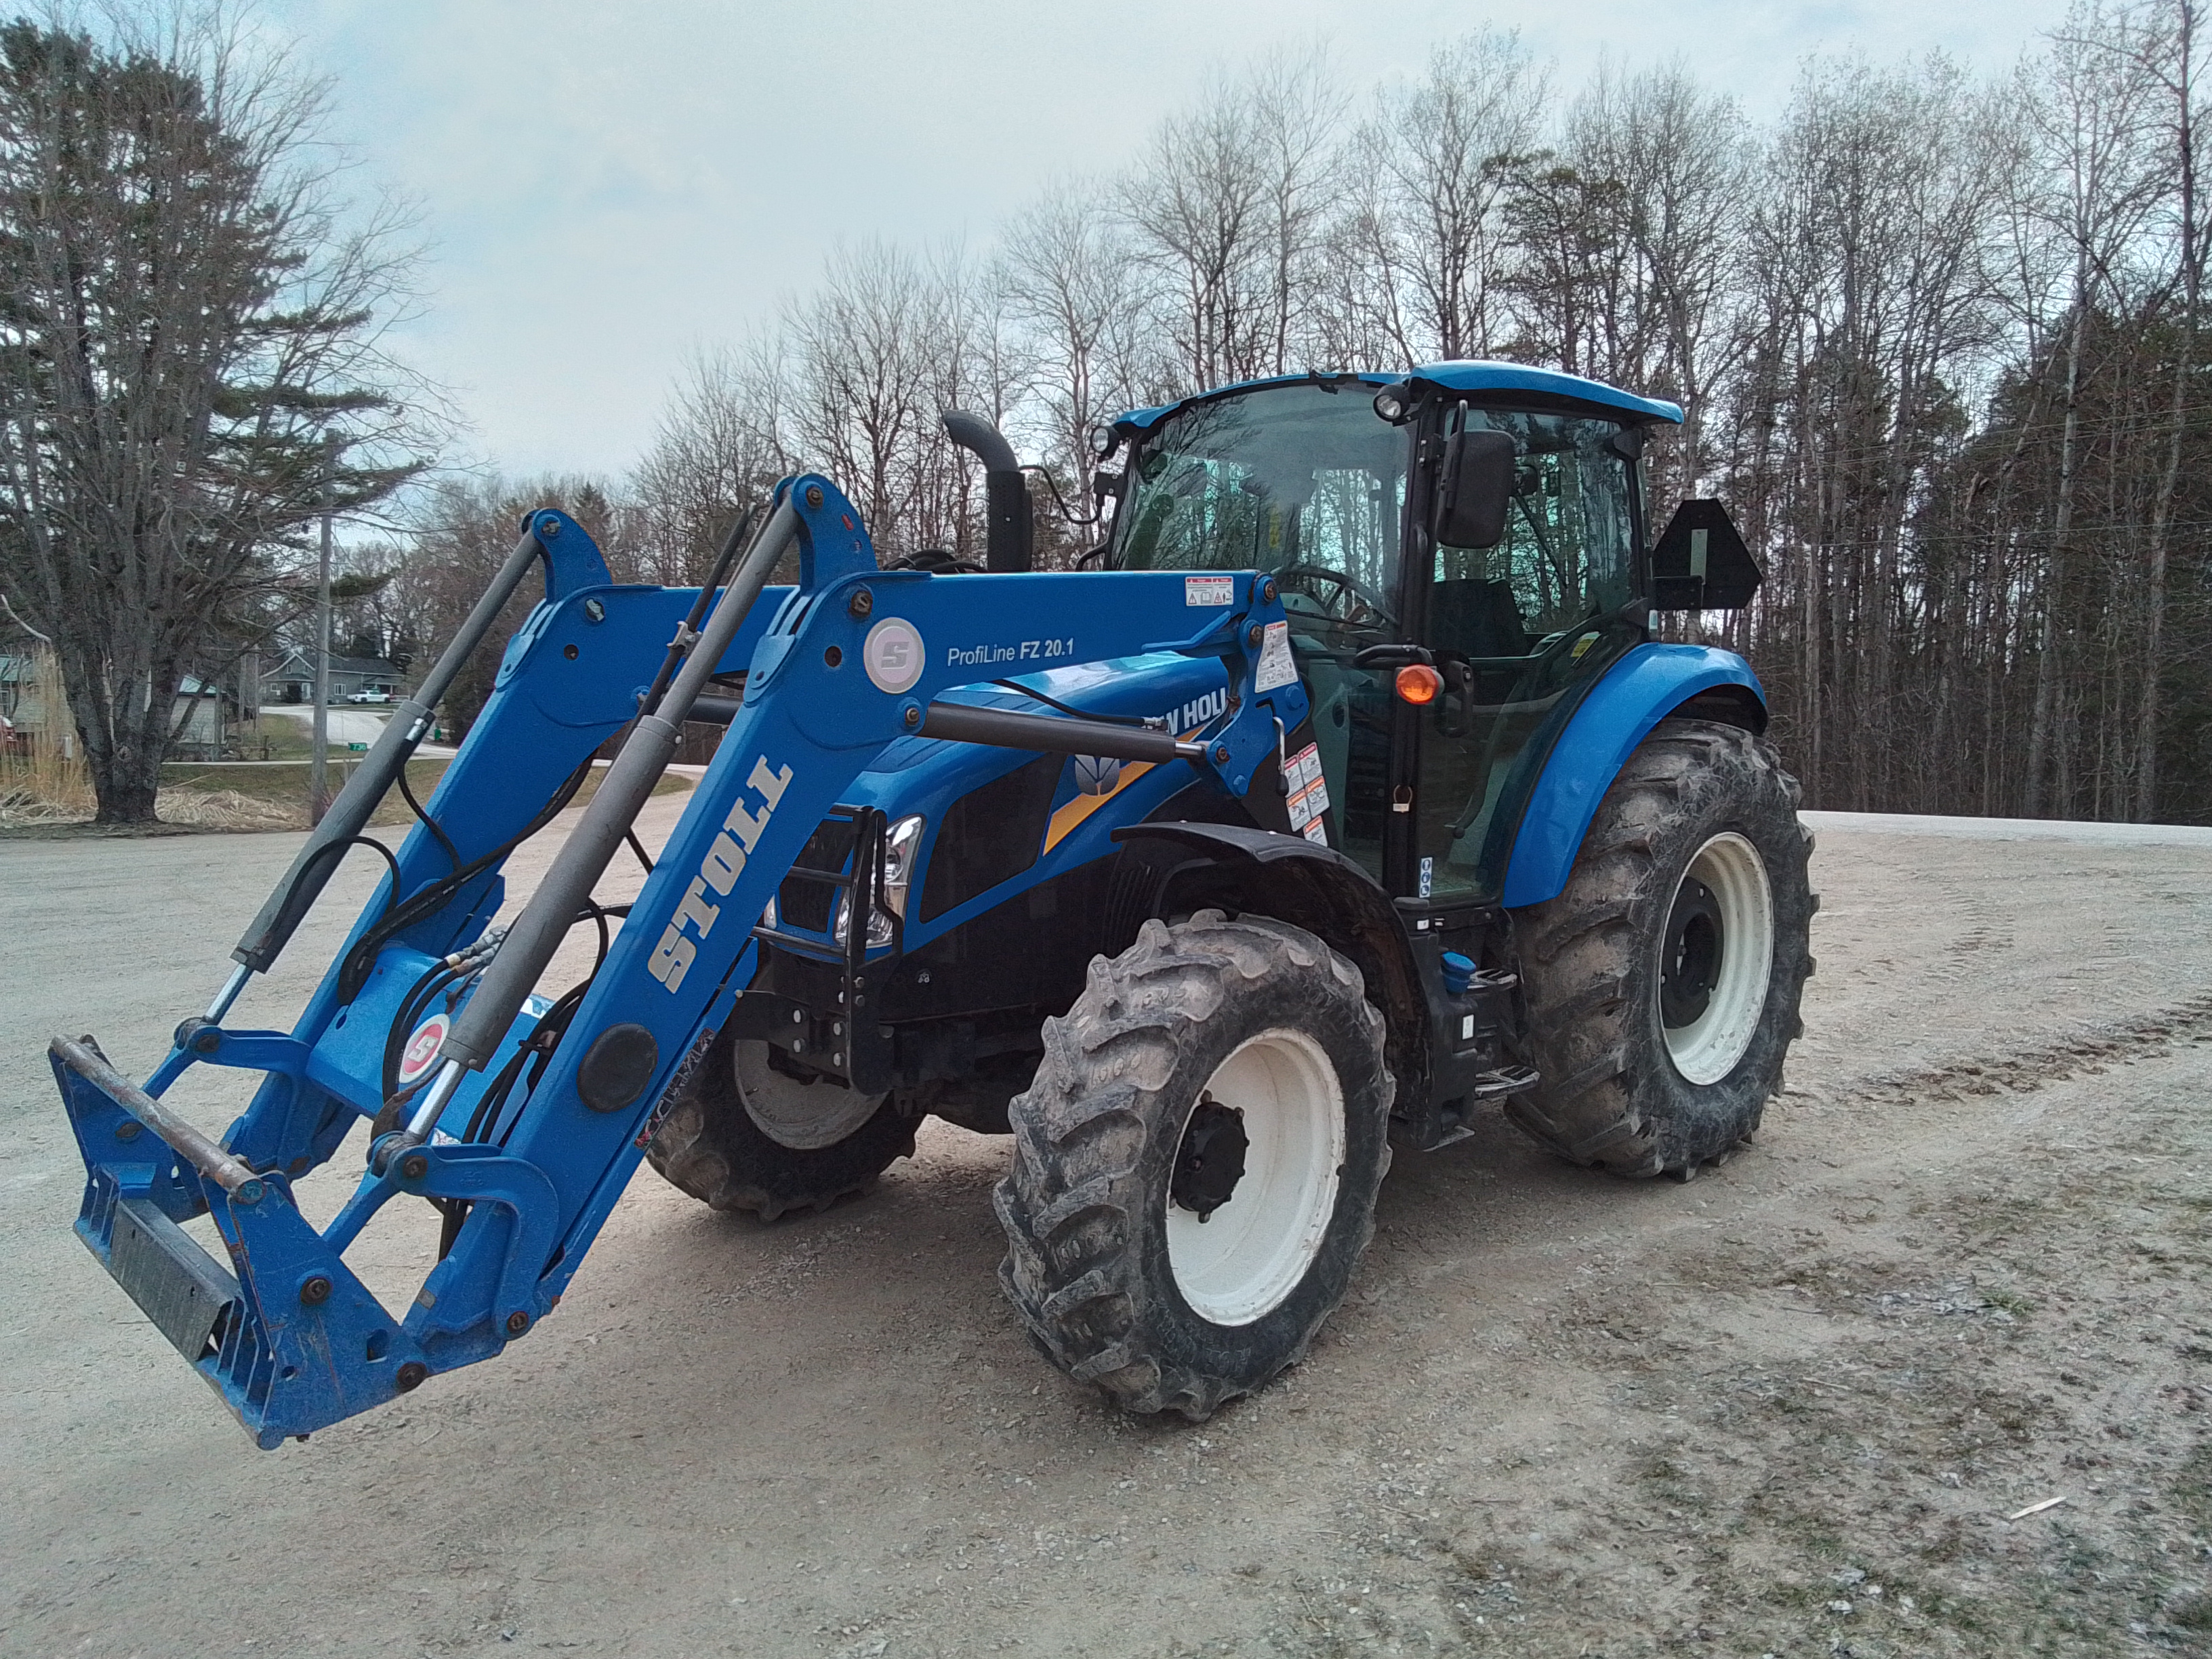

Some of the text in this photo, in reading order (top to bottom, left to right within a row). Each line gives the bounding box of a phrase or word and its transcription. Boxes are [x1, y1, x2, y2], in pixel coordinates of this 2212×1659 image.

[947, 638, 1074, 666] ProfiLine FZ 20.1
[647, 754, 794, 994] STOLL
